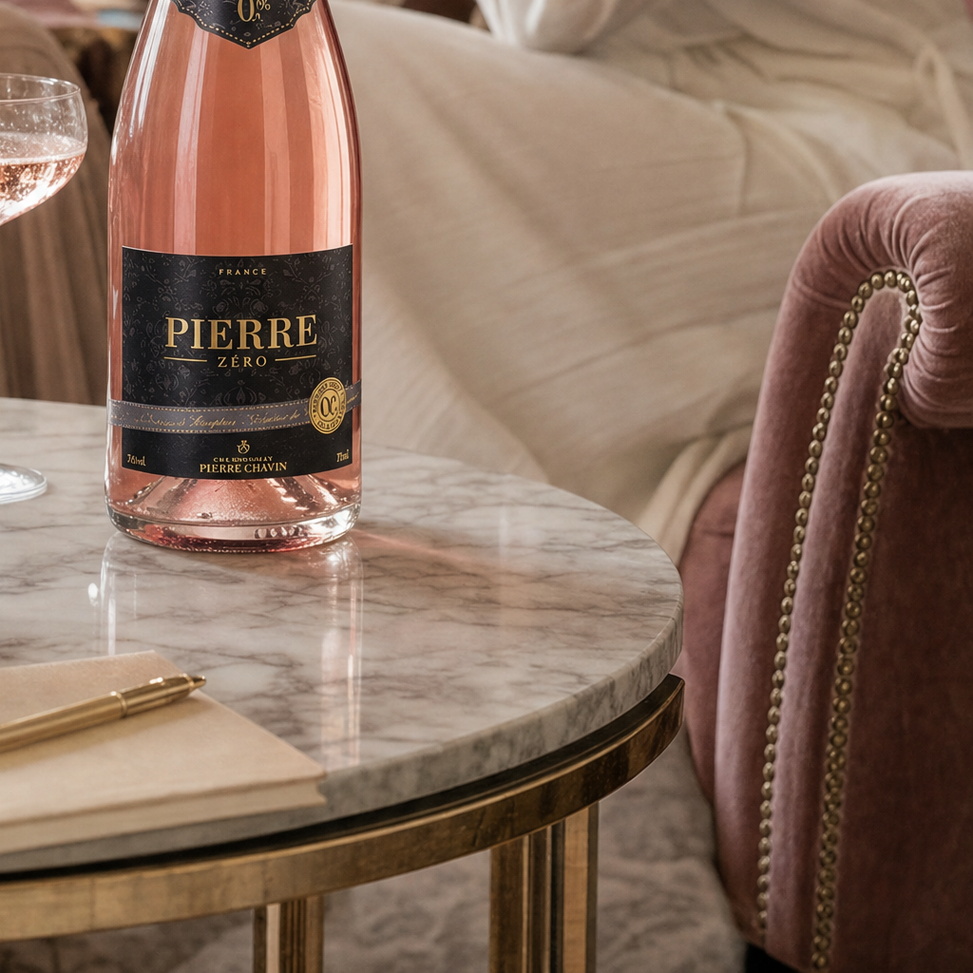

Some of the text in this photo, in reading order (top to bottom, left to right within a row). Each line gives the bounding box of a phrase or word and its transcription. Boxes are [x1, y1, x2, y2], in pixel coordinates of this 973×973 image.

[219, 268, 267, 276] FRANCE
[165, 314, 318, 350] PIERRE
[217, 355, 267, 368] ZÉRO
[199, 462, 288, 473] PIERRE CHAVIN
